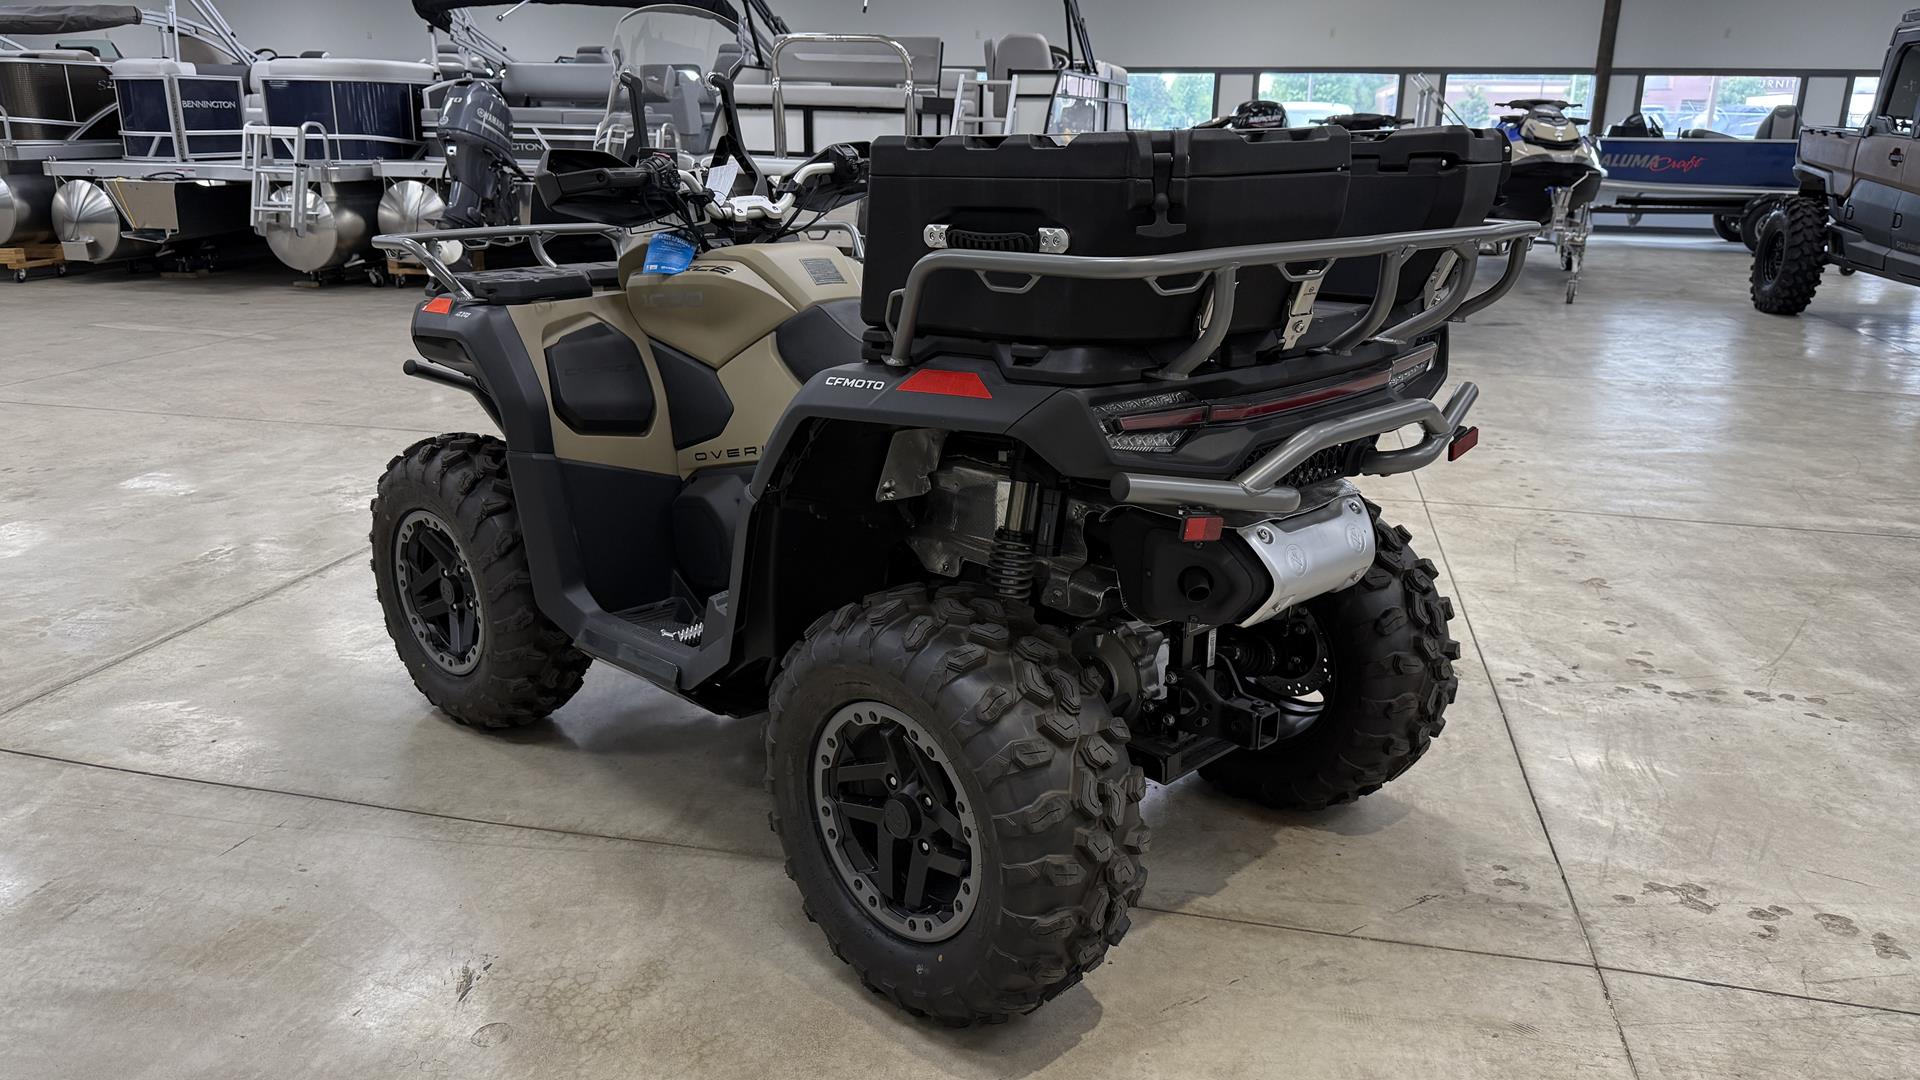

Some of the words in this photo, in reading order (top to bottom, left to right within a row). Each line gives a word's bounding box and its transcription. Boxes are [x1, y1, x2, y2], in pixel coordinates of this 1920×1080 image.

[182, 100, 236, 109] BENNINGTON
[1601, 153, 1660, 168] ALUMA
[1649, 155, 1708, 173] Craft
[825, 376, 885, 390] CFMOTO
